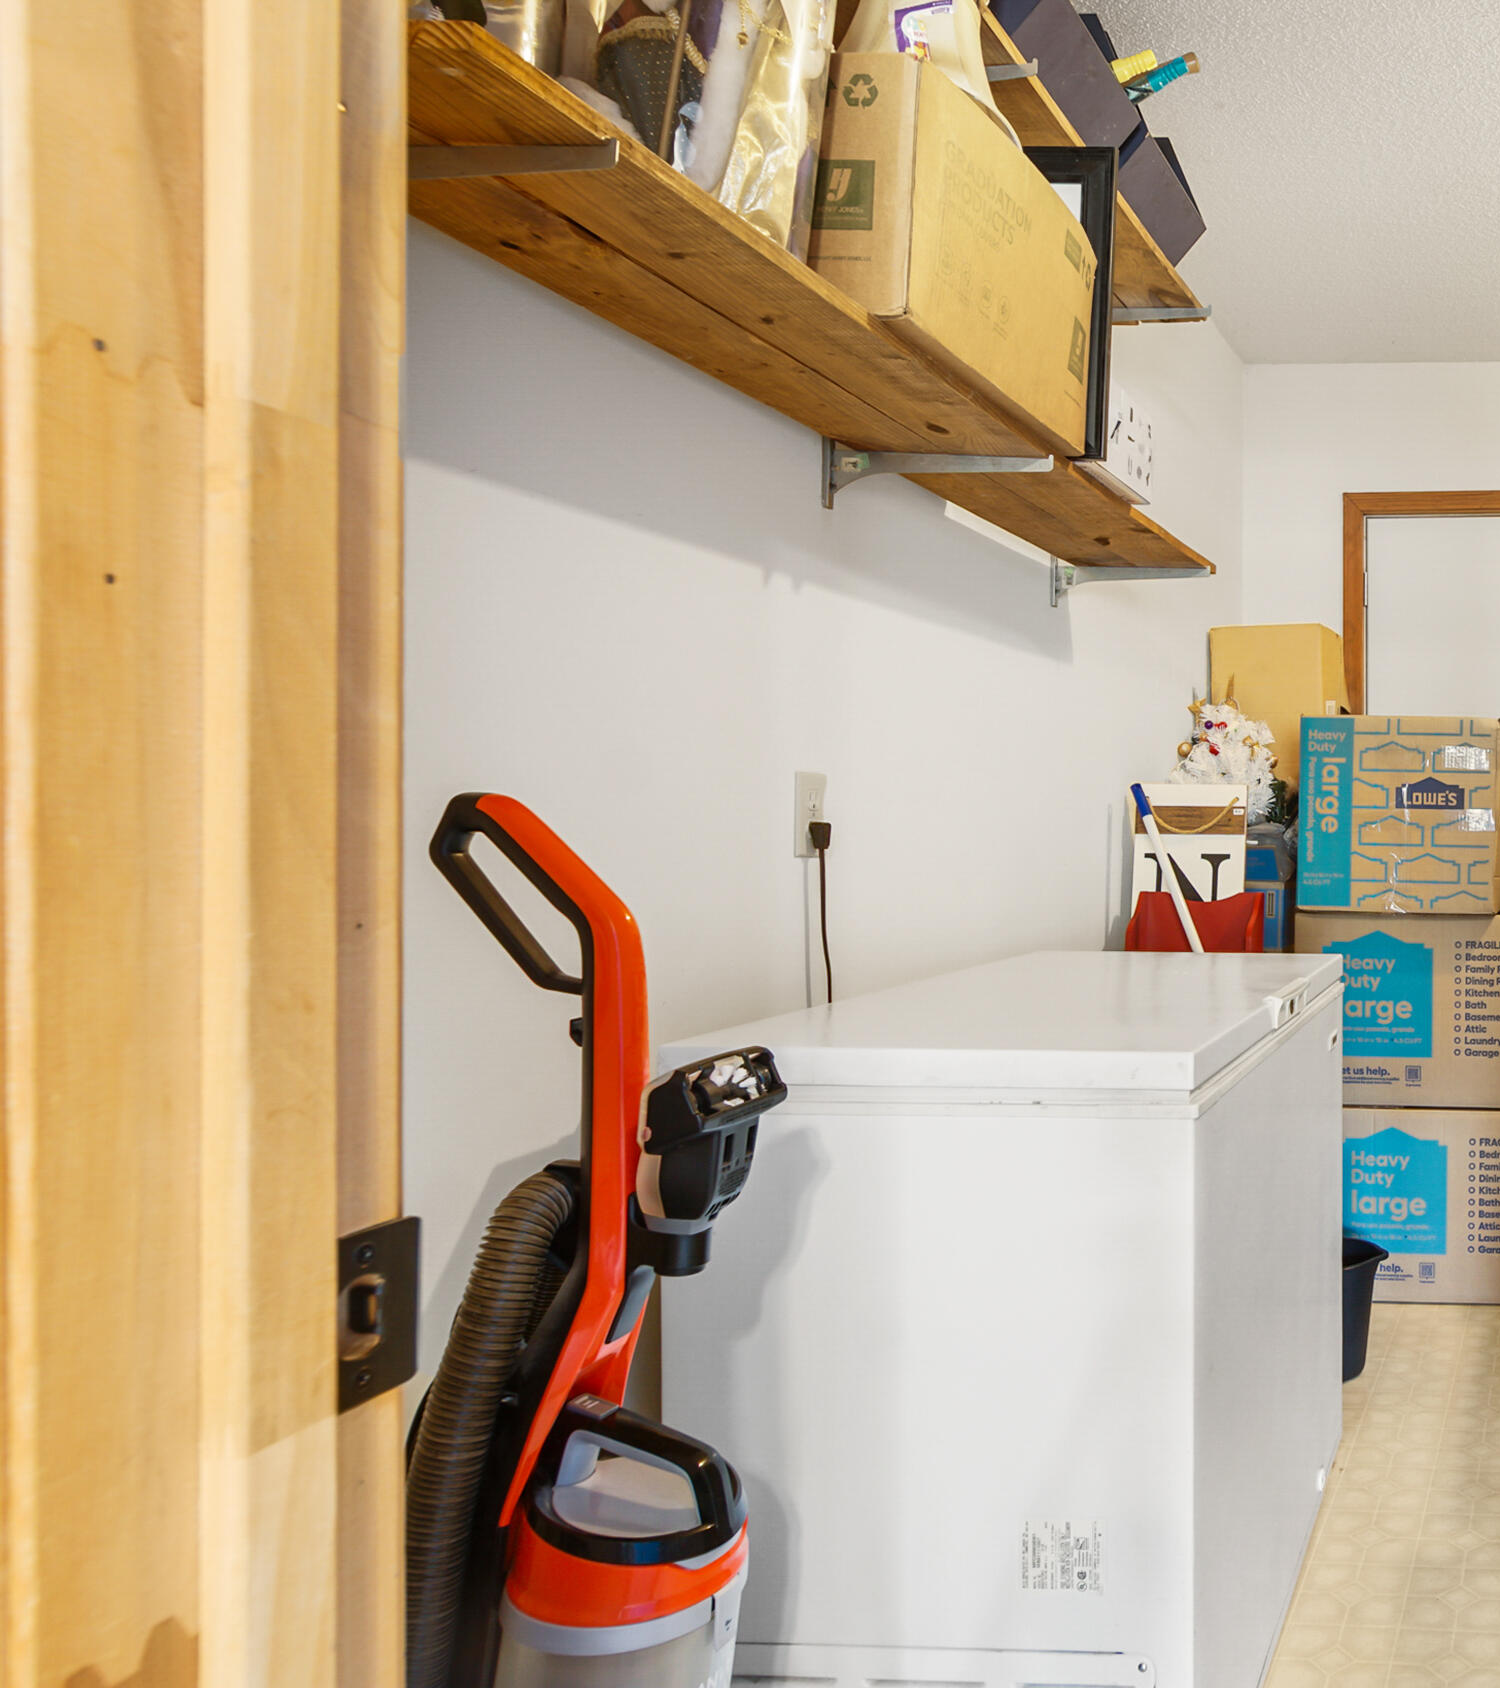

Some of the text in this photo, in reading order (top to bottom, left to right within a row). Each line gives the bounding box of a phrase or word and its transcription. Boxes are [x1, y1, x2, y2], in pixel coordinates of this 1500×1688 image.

[944, 164, 1016, 245] PRODUCTS
[1308, 729, 1346, 742] Heavy
[1308, 741, 1336, 753] Duty
[1315, 757, 1346, 834] large
[1465, 965, 1495, 974] Family
[1465, 977, 1494, 987] Dining
[1465, 989, 1500, 997] Kitchen
[1465, 1001, 1487, 1009] Bath
[1344, 1000, 1413, 1025] arge
[1464, 1025, 1487, 1033] Attic
[1464, 1048, 1500, 1058] Garage
[1342, 1066, 1391, 1077] et us help.
[1351, 1150, 1410, 1171] Heavy
[1351, 1168, 1395, 1189] Duty
[1351, 1189, 1427, 1222] large
[1479, 1198, 1500, 1207] Bath
[1478, 1222, 1500, 1230] Attic
[1379, 1264, 1404, 1273] help.
